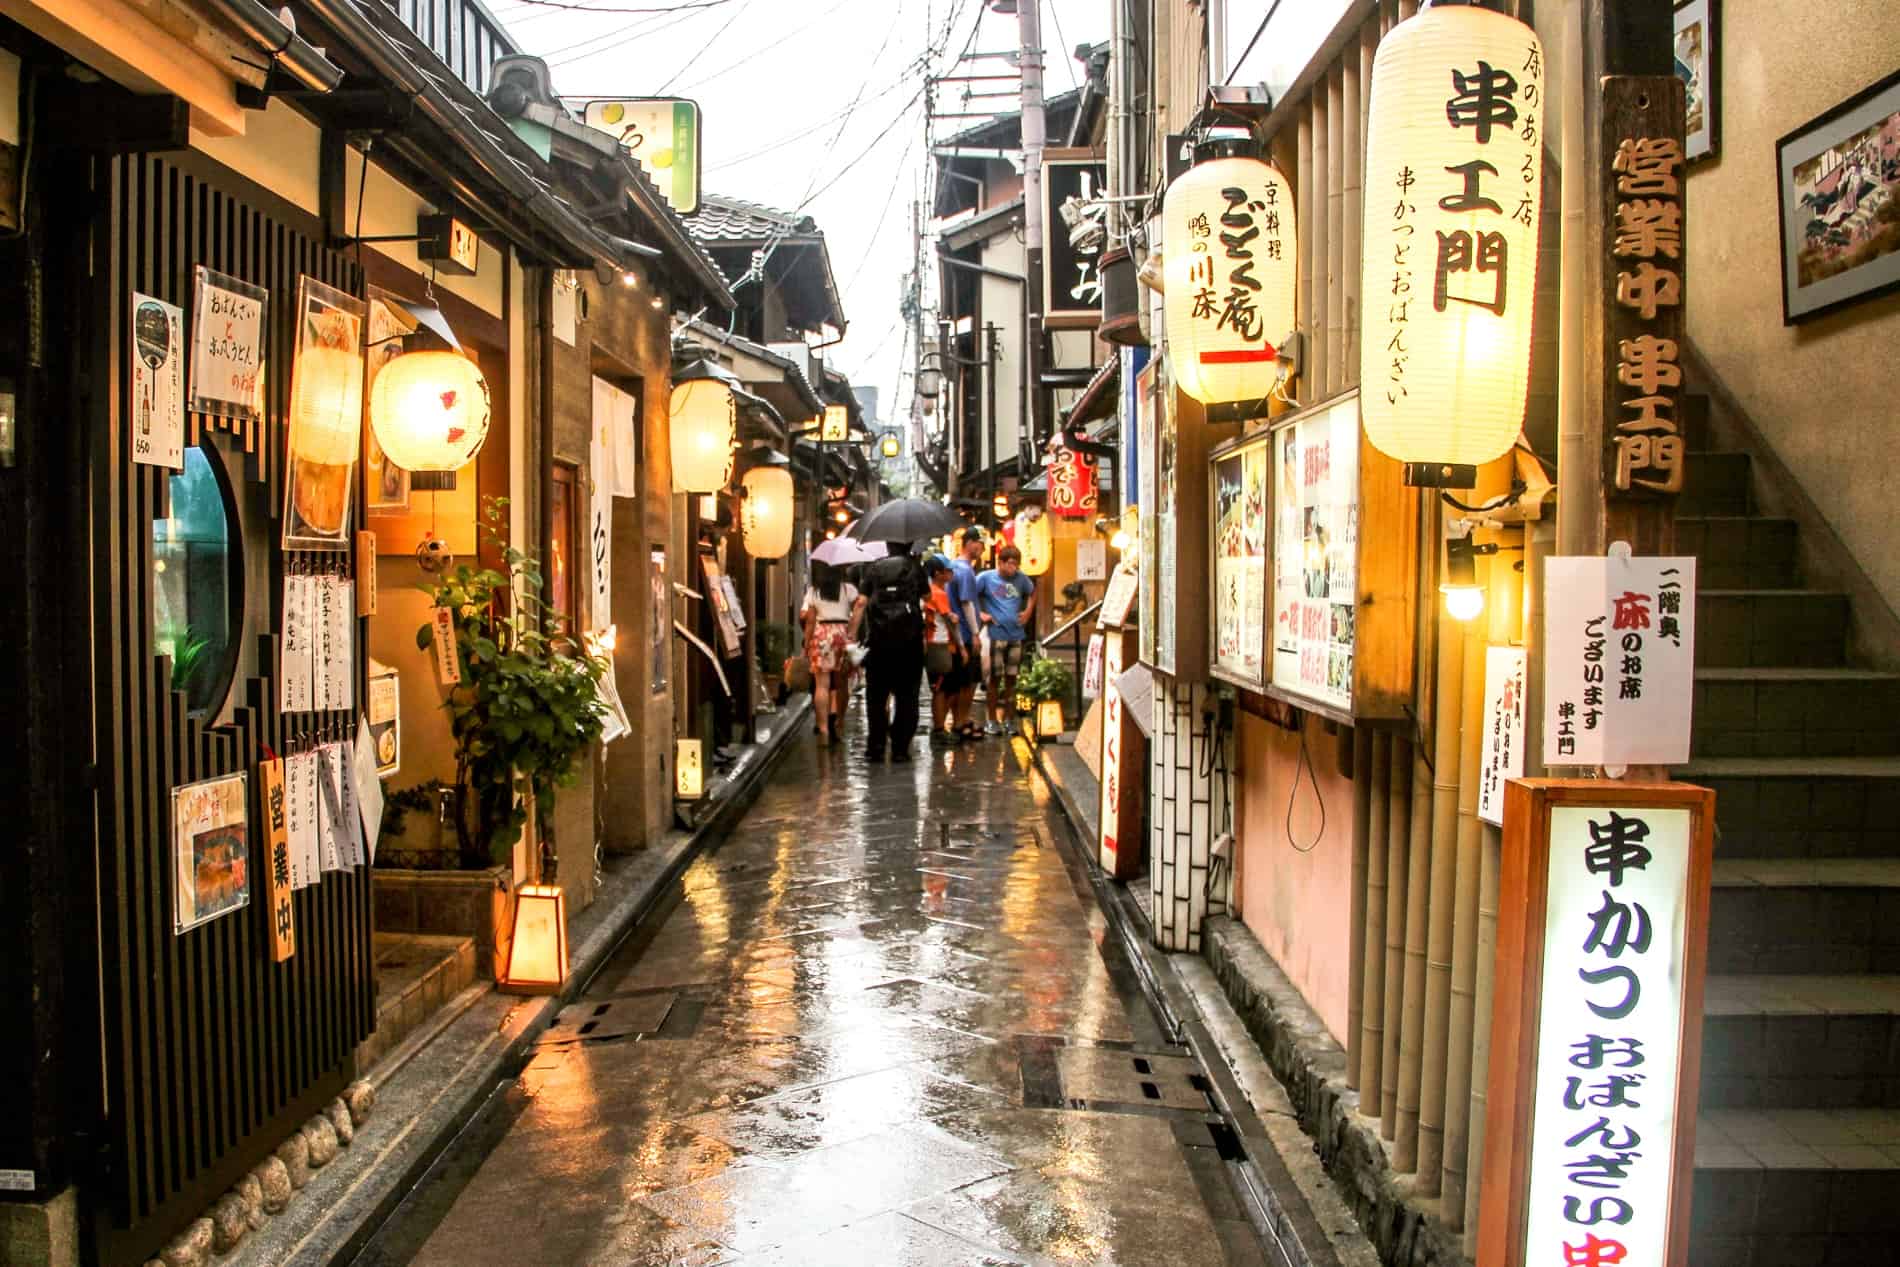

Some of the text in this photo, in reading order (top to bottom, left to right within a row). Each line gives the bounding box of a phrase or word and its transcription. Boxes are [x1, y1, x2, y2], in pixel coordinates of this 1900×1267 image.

[1434, 60, 1518, 316] 串工門
[1512, 41, 1541, 228] 床のある店
[1188, 212, 1221, 319] 鴨の川床
[1217, 187, 1266, 342] ごとく庵
[1264, 181, 1283, 260] 京料理
[1388, 166, 1416, 405] 串かつとおばんざい
[1613, 138, 1684, 493] 営業中 串工門
[1051, 445, 1077, 508] おでん
[1583, 616, 1607, 730] ございます
[1612, 591, 1651, 699] 床のお席
[1557, 701, 1576, 756] 串工門
[270, 783, 292, 943] 営業中
[1578, 811, 1652, 1020] 串かつ
[1562, 1033, 1647, 1226] おばんざい
